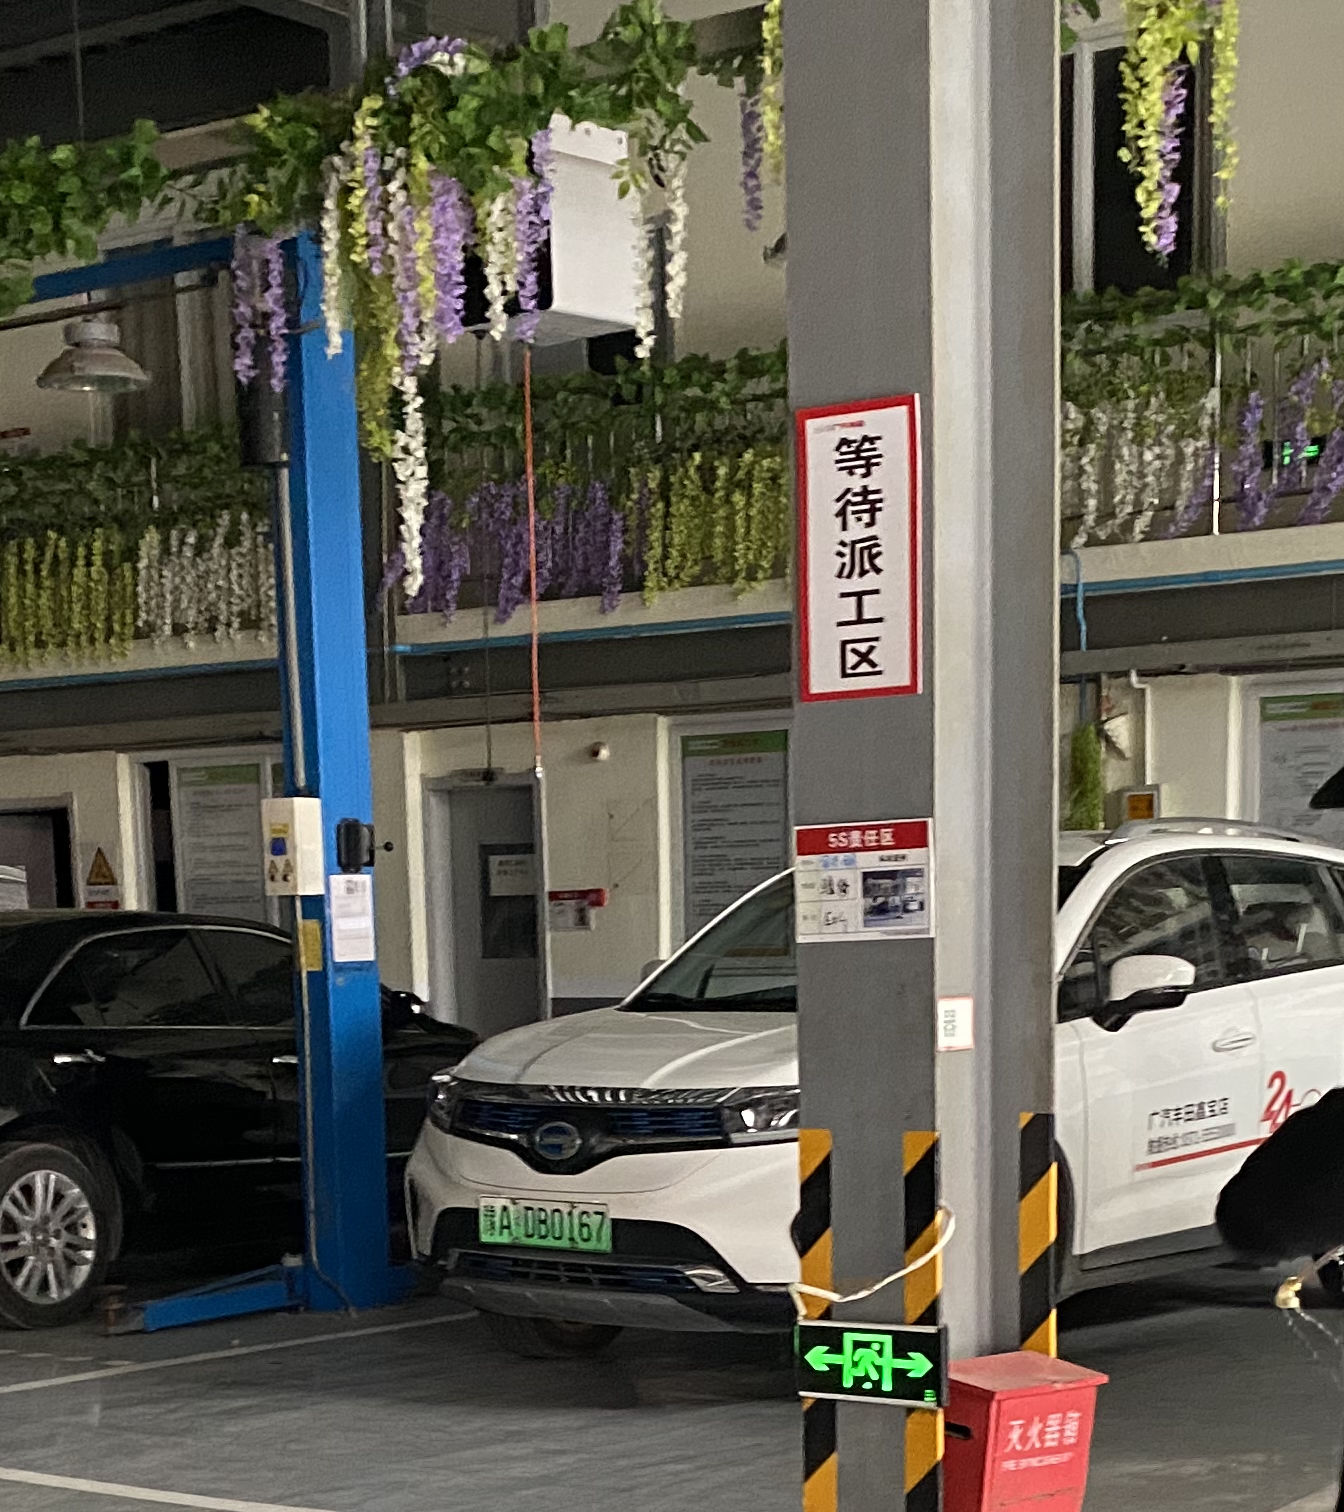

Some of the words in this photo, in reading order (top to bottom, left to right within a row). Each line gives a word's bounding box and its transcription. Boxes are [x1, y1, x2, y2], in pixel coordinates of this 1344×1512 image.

[834, 434, 884, 679] 等待派工区
[827, 828, 895, 848] 5S责任区
[1004, 1410, 1083, 1453] 灭火器箱
